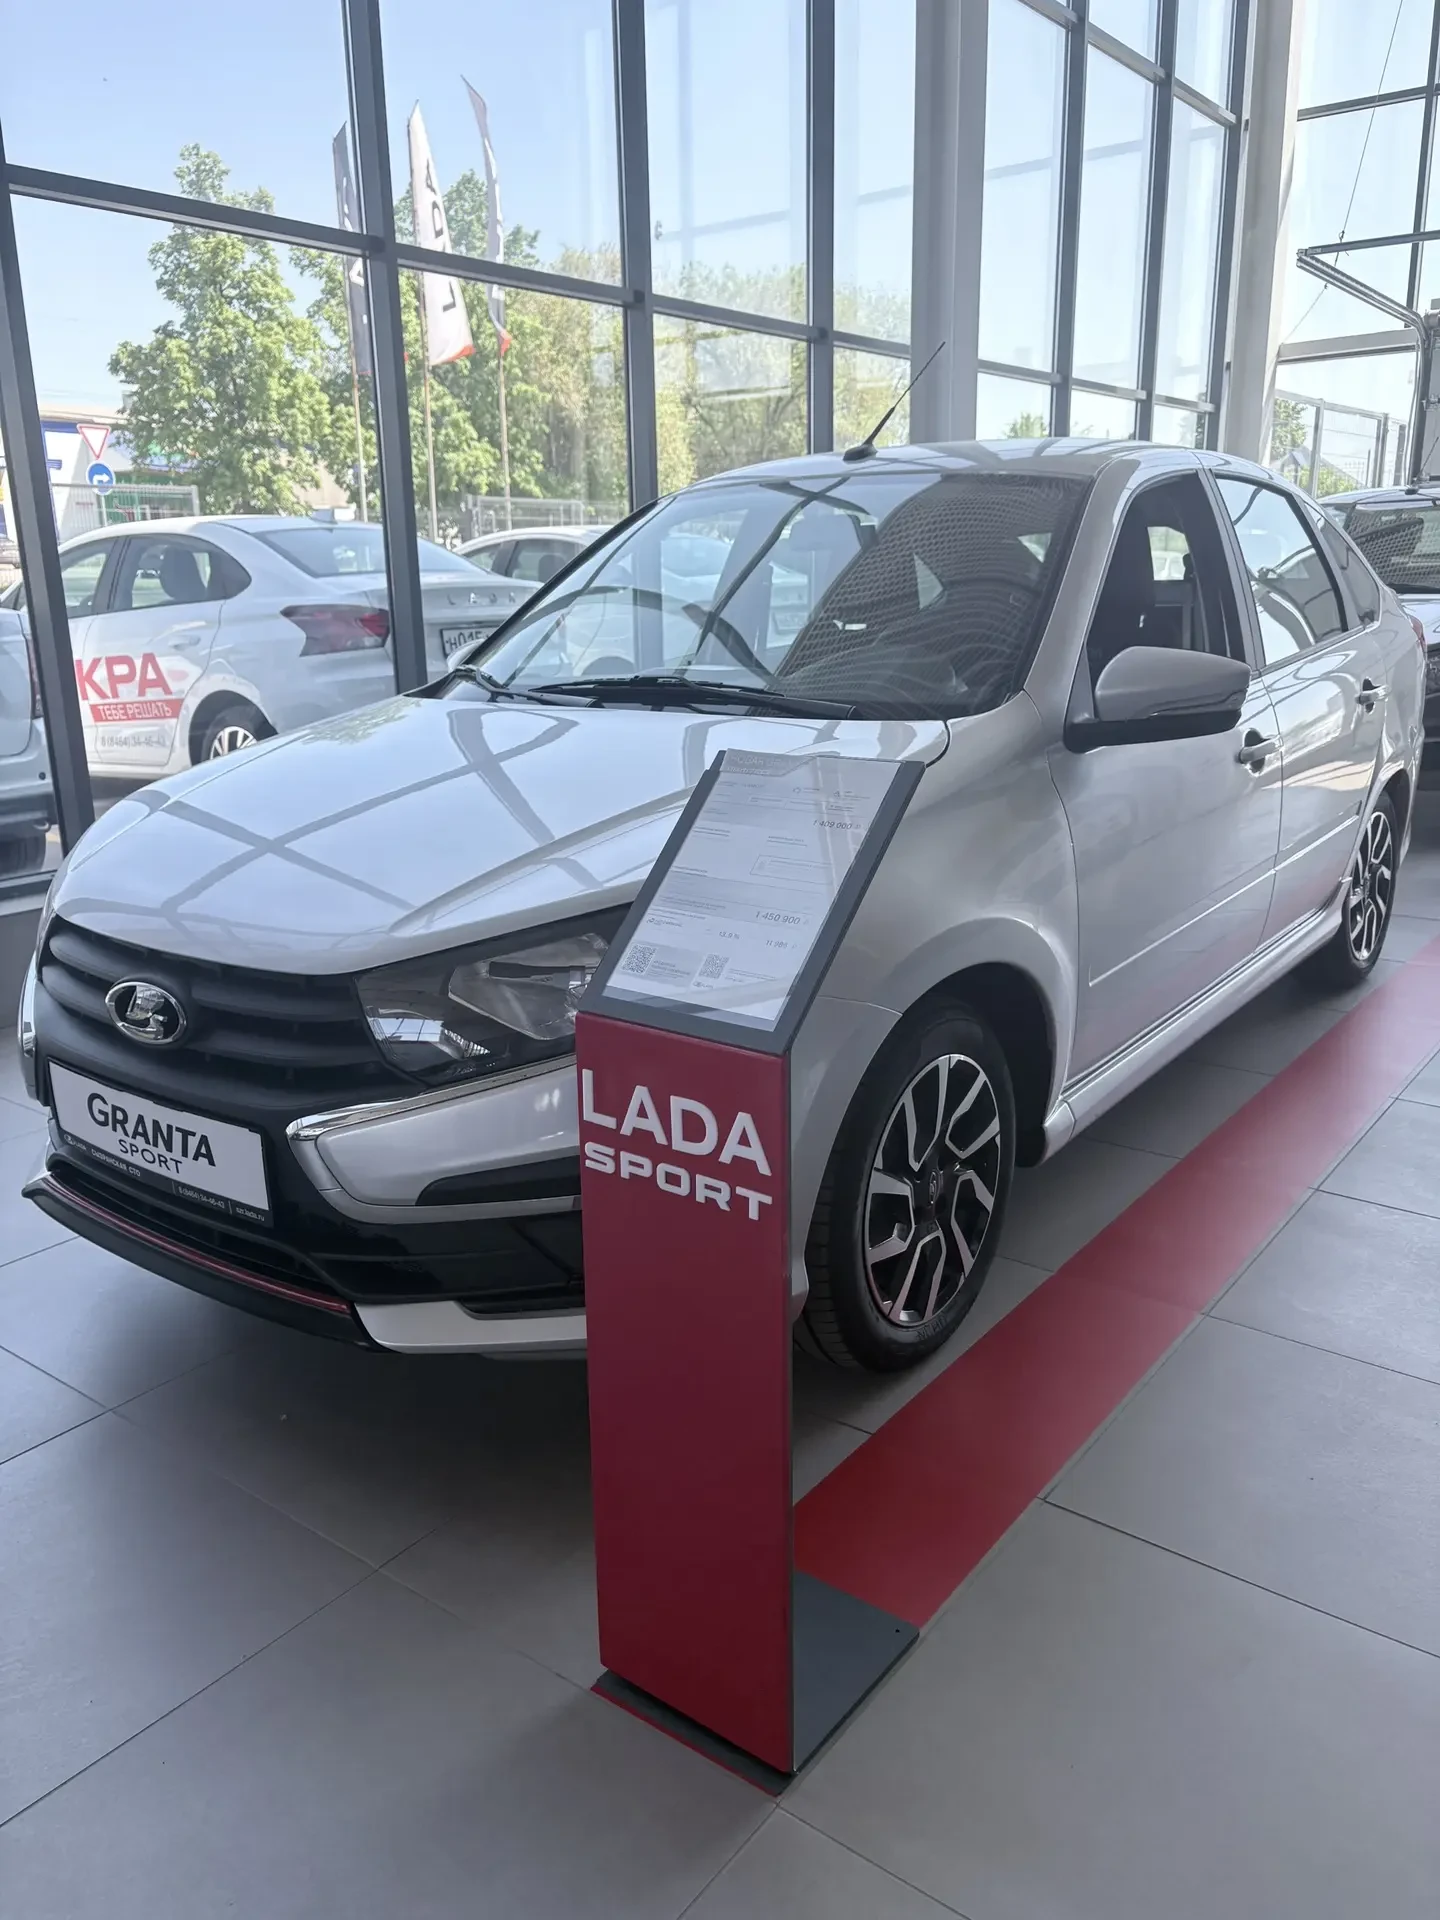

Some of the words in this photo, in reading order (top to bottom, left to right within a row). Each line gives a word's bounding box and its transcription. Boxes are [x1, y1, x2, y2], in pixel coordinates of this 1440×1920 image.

[426, 158, 456, 313] LDA
[98, 704, 127, 721] ТЕБЕ
[127, 702, 172, 718] РЕШАТЬ
[762, 912, 781, 921] 450
[782, 915, 801, 925] 900
[87, 1092, 216, 1167] GRANTA
[582, 1068, 772, 1176] LADA
[118, 1139, 183, 1174] SPORT
[128, 1166, 141, 1177] СТО
[584, 1141, 773, 1220] SPORT
